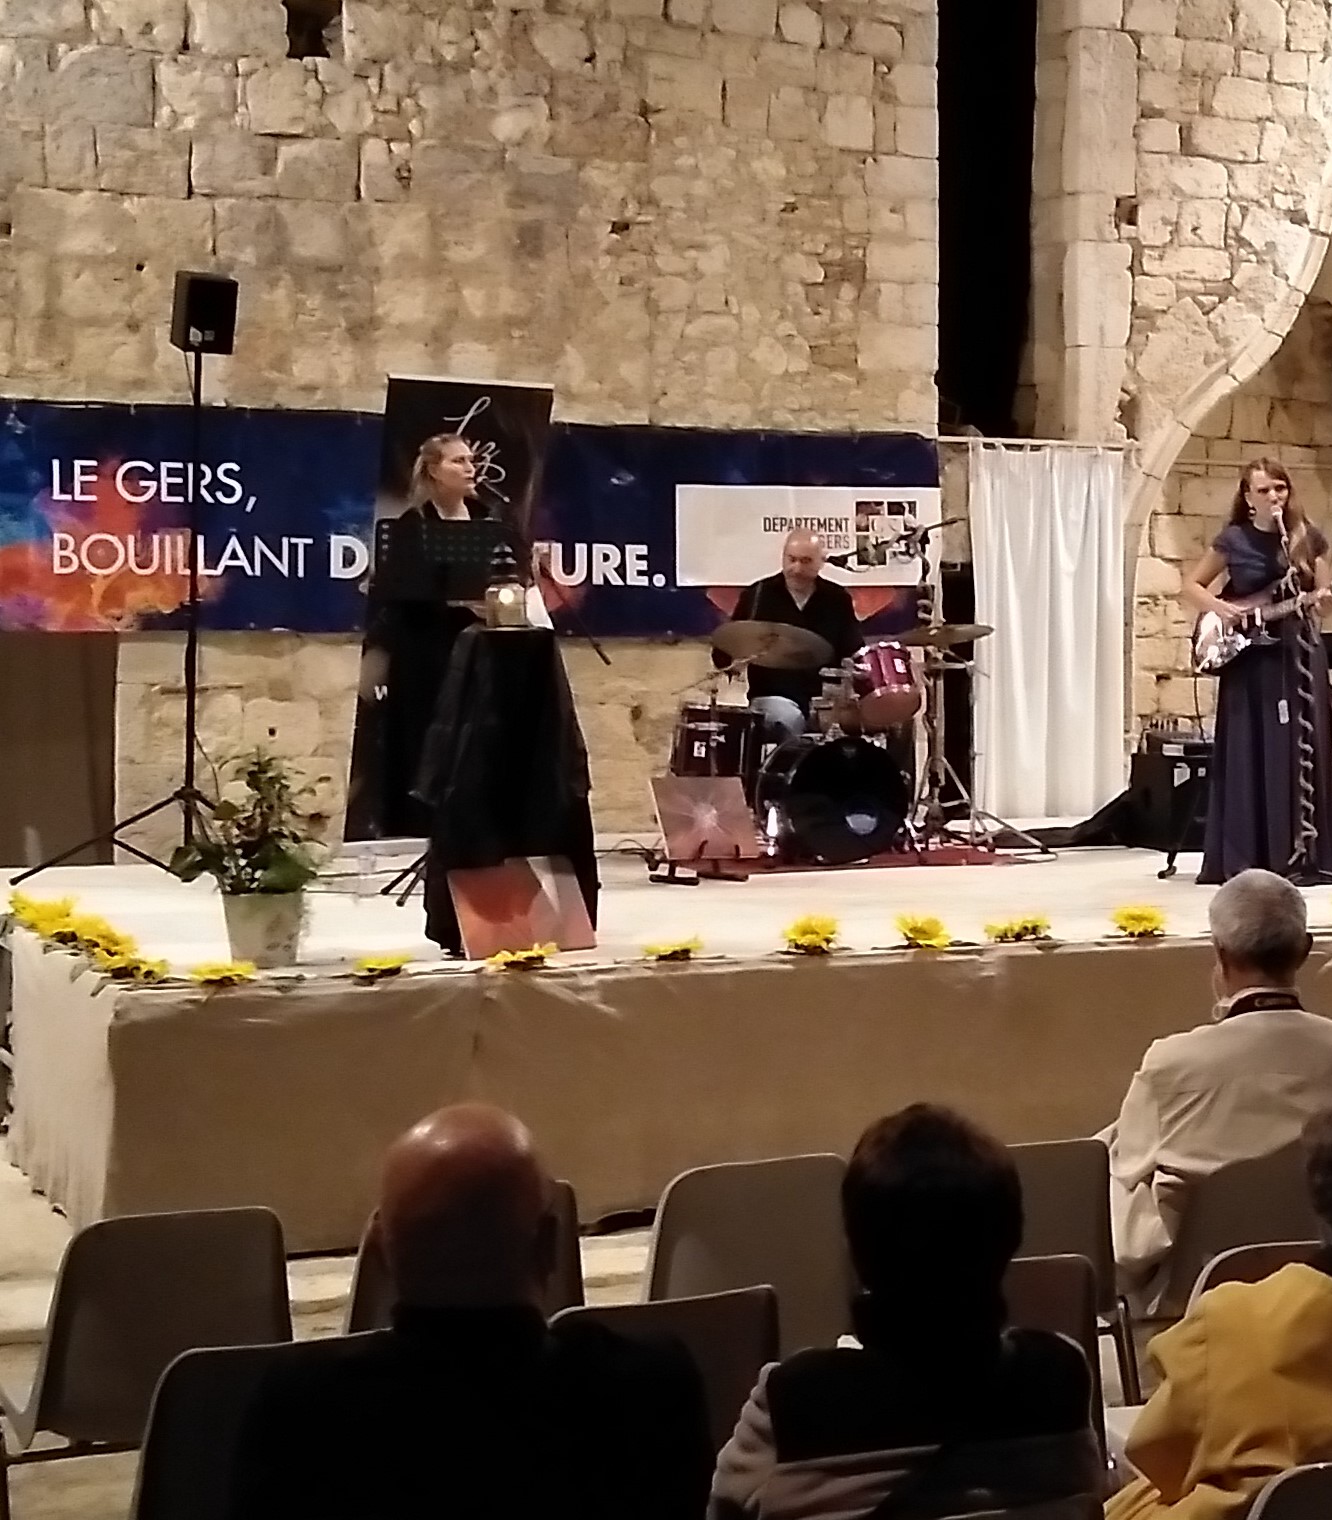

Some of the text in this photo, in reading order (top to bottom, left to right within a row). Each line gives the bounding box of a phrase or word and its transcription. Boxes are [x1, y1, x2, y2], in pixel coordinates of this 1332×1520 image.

[51, 458, 257, 513] LE GERS,
[52, 532, 314, 579] BOUILLANT
